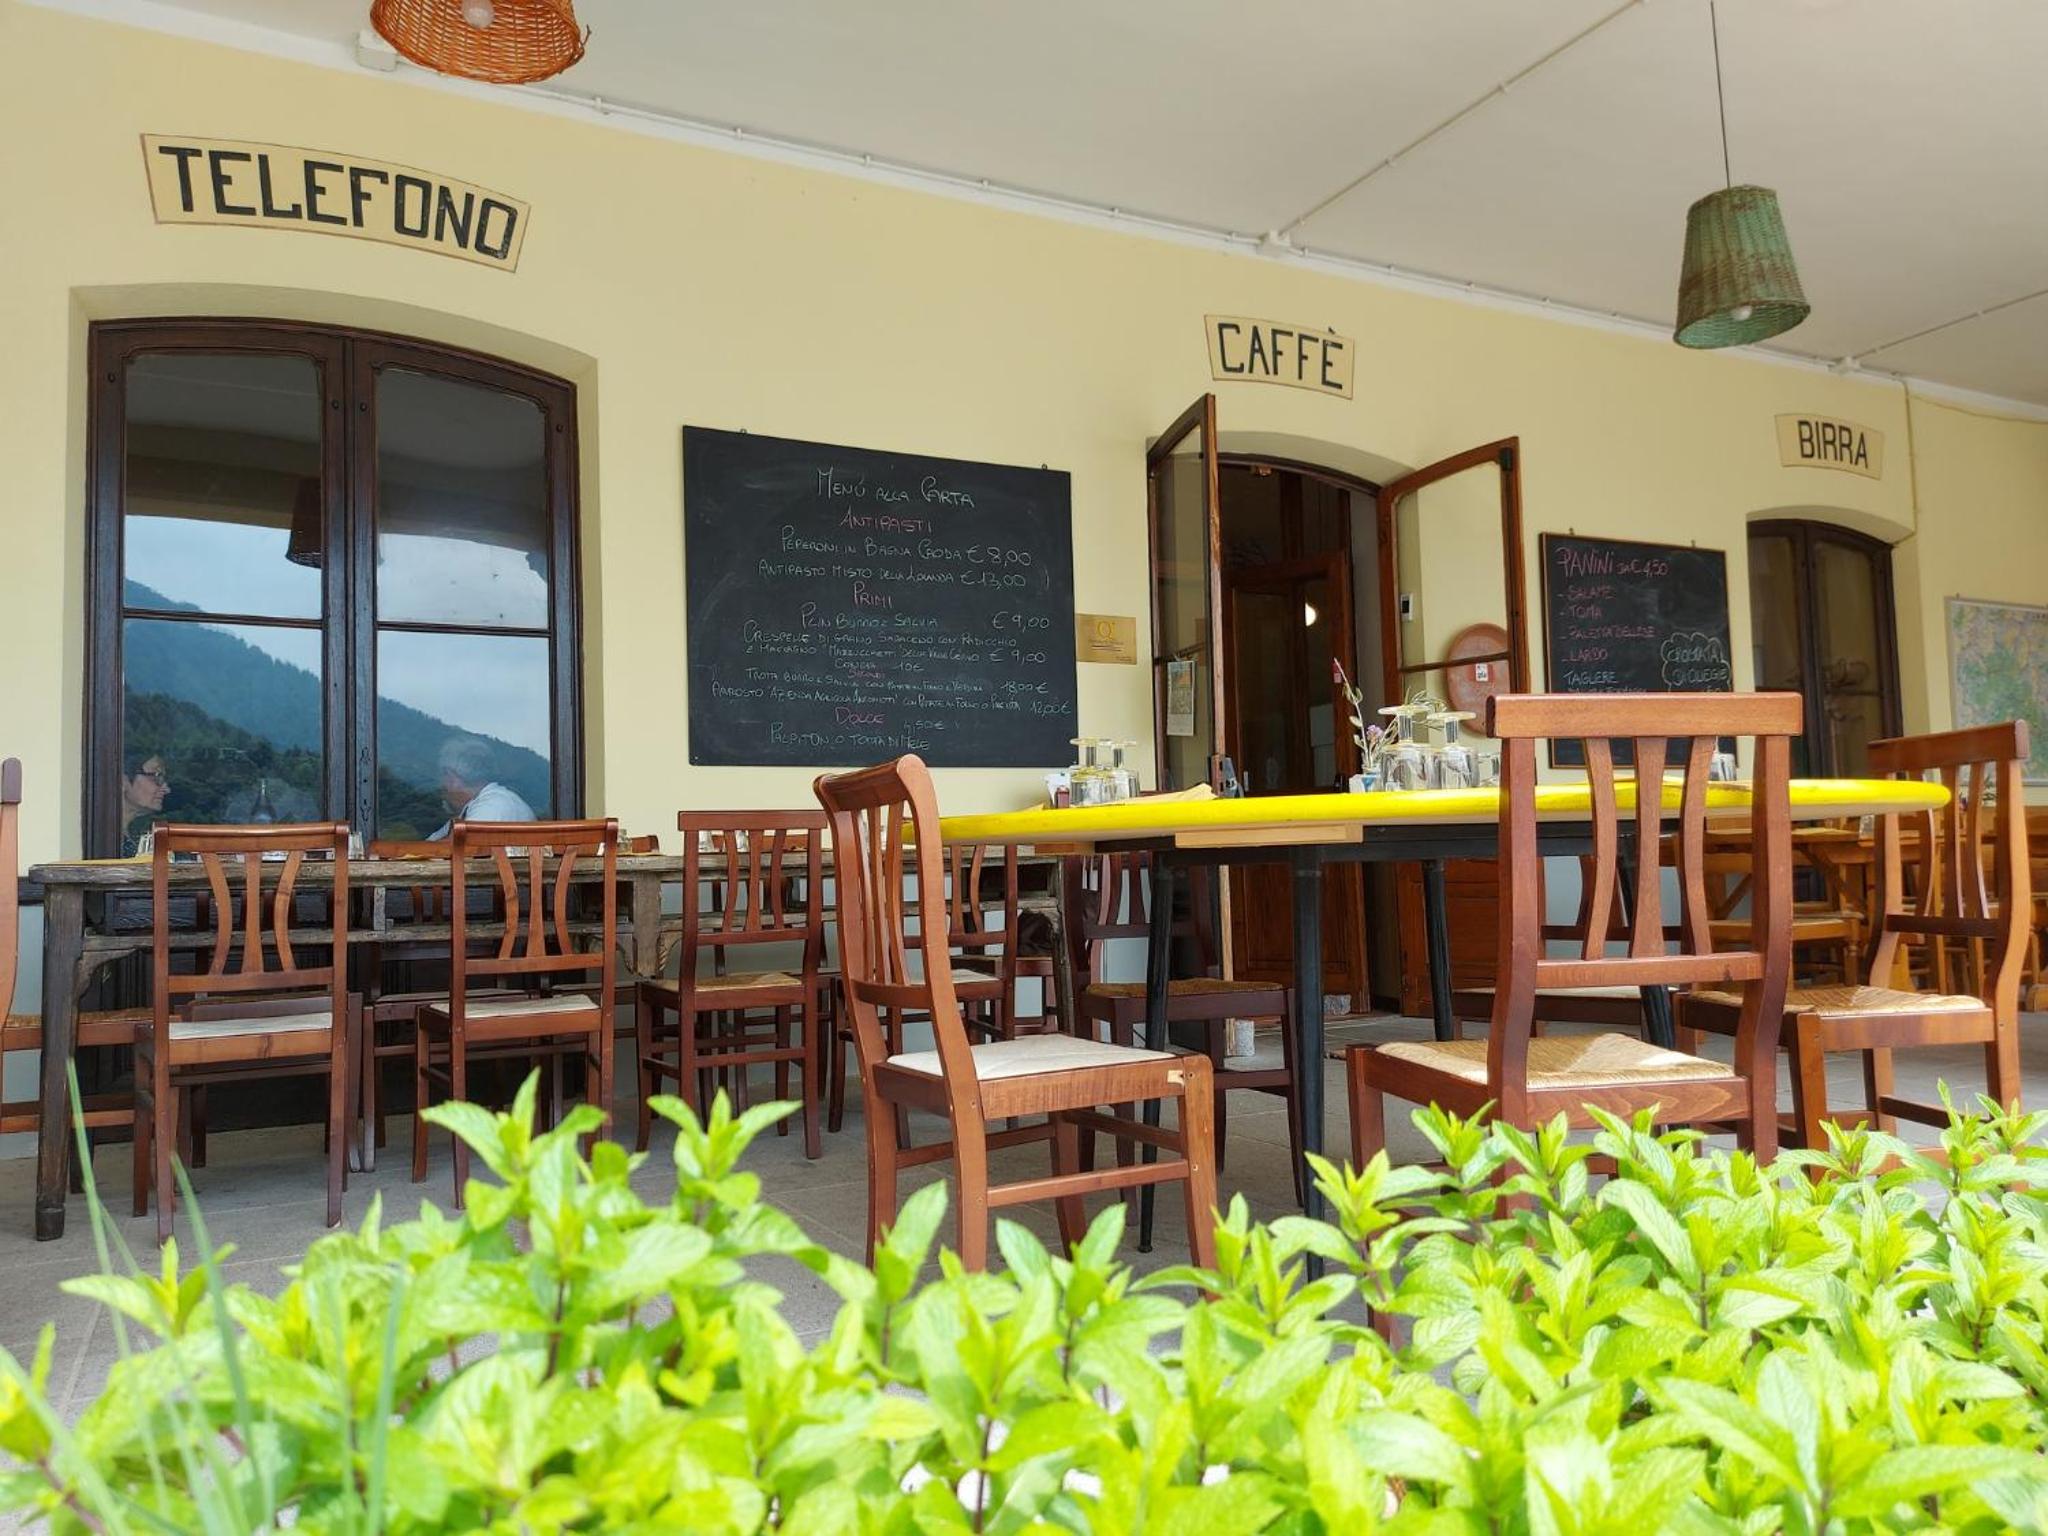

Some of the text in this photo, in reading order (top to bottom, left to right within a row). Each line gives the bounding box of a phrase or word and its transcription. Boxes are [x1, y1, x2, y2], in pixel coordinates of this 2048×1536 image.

[158, 146, 518, 260] TELEFONO
[1218, 326, 1343, 390] CAFFÈ
[1797, 420, 1869, 469] BIRRA
[921, 475, 975, 508] CARTA
[839, 505, 932, 534] ANTIPASTI
[758, 559, 826, 579] ANTIPASTO
[832, 565, 872, 578] MISTO
[853, 580, 894, 608] PRIMI
[1569, 603, 1602, 619] TOMA
[834, 706, 885, 726] DOLCE
